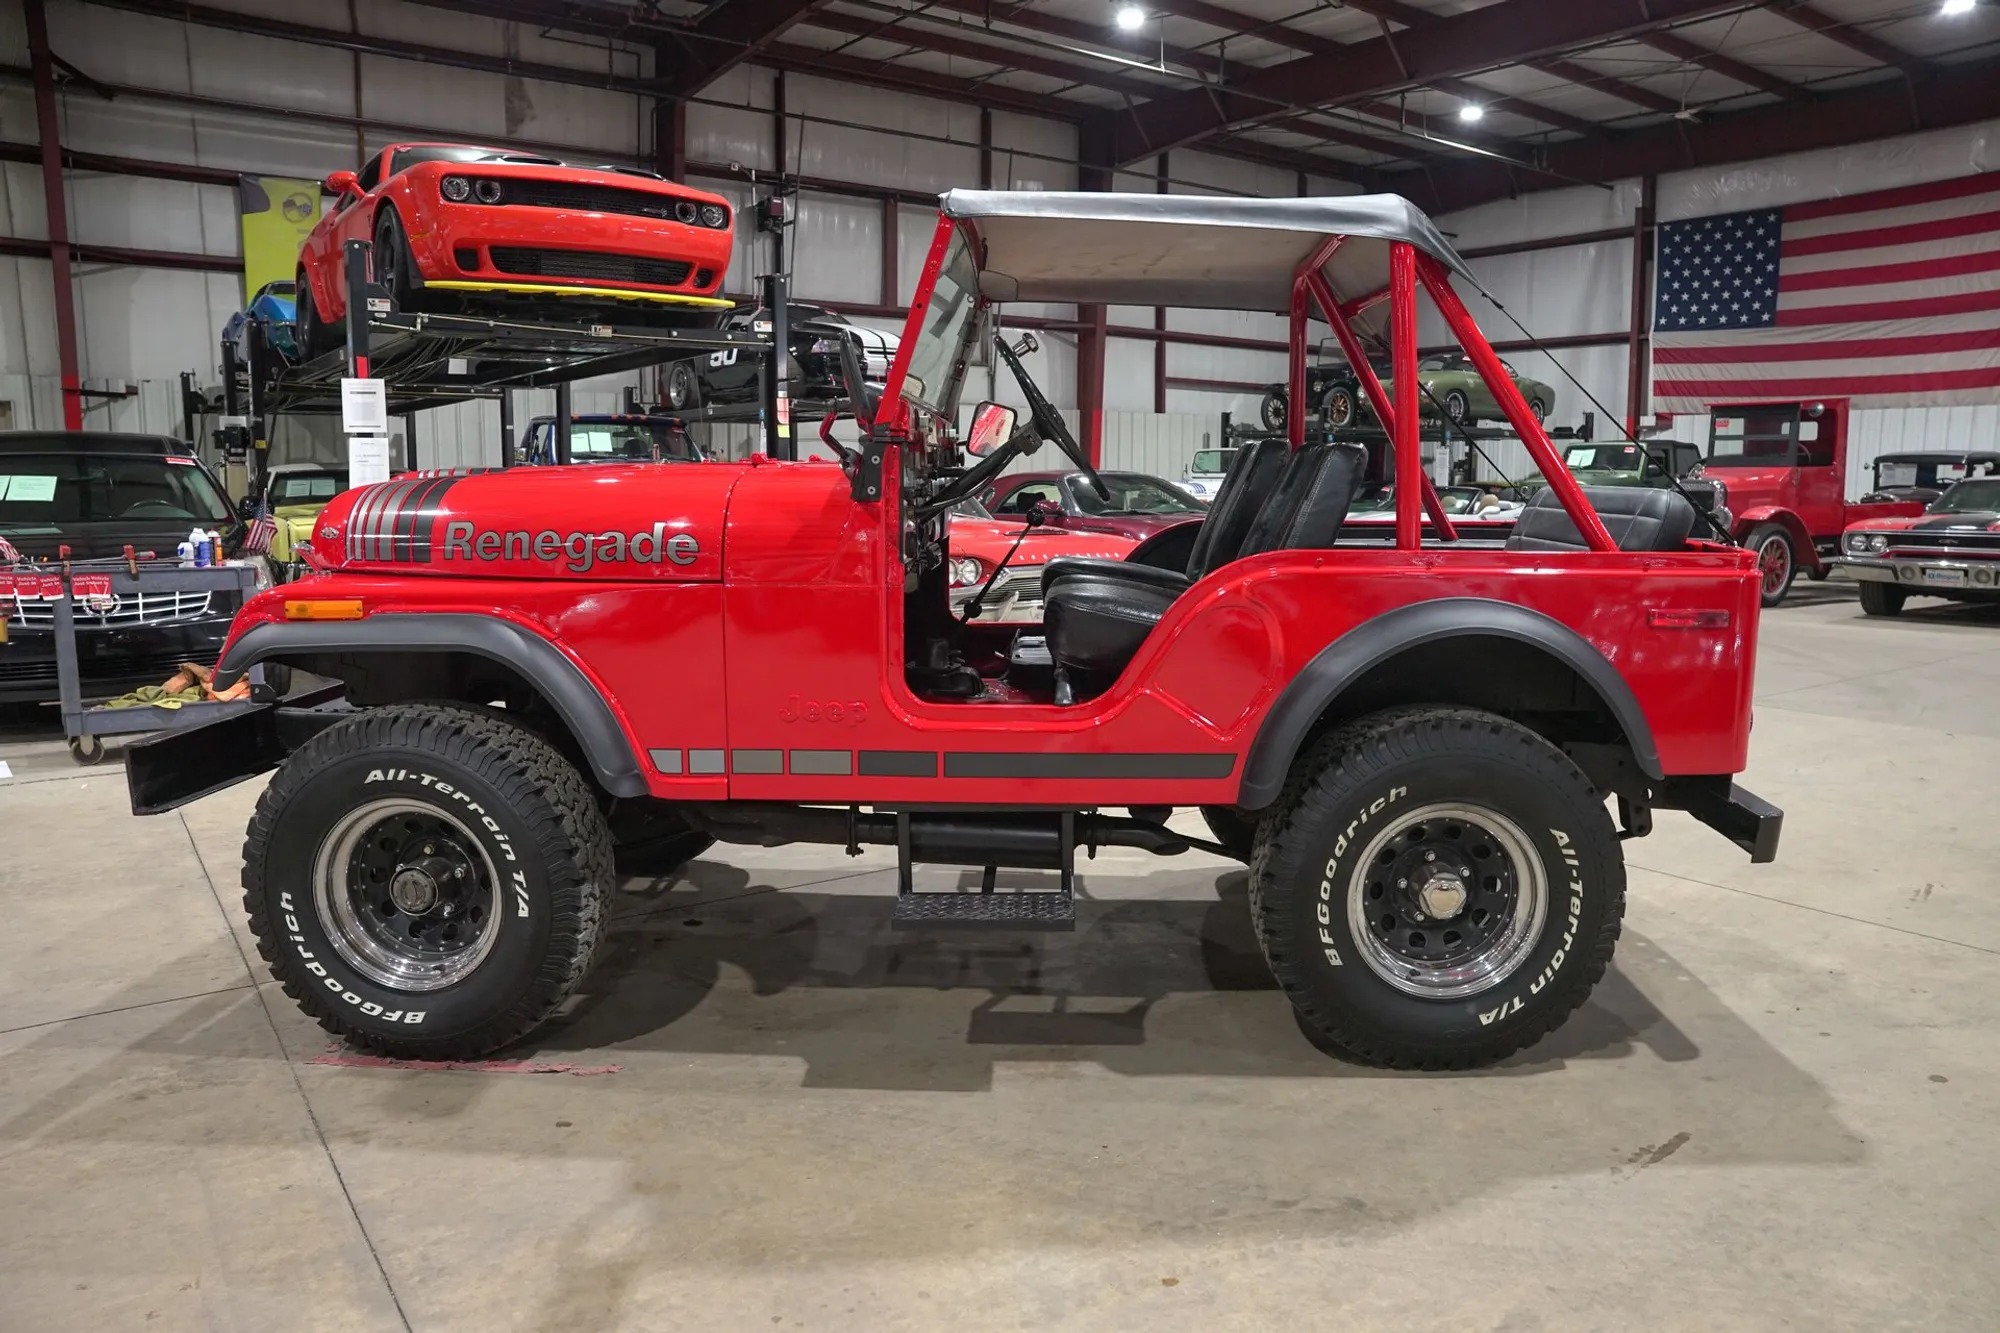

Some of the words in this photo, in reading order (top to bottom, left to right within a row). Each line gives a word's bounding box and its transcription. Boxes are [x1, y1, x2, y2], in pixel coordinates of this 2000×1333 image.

[443, 520, 699, 573] Renegade
[778, 694, 868, 728] Jeep
[364, 768, 516, 861] All-Terrain
[512, 869, 530, 917] T/A
[1316, 786, 1407, 966] BFGoodrich
[280, 891, 426, 1024] BFGoodrich
[1529, 828, 1584, 995] All-Terrain
[1478, 995, 1525, 1026] T/A
